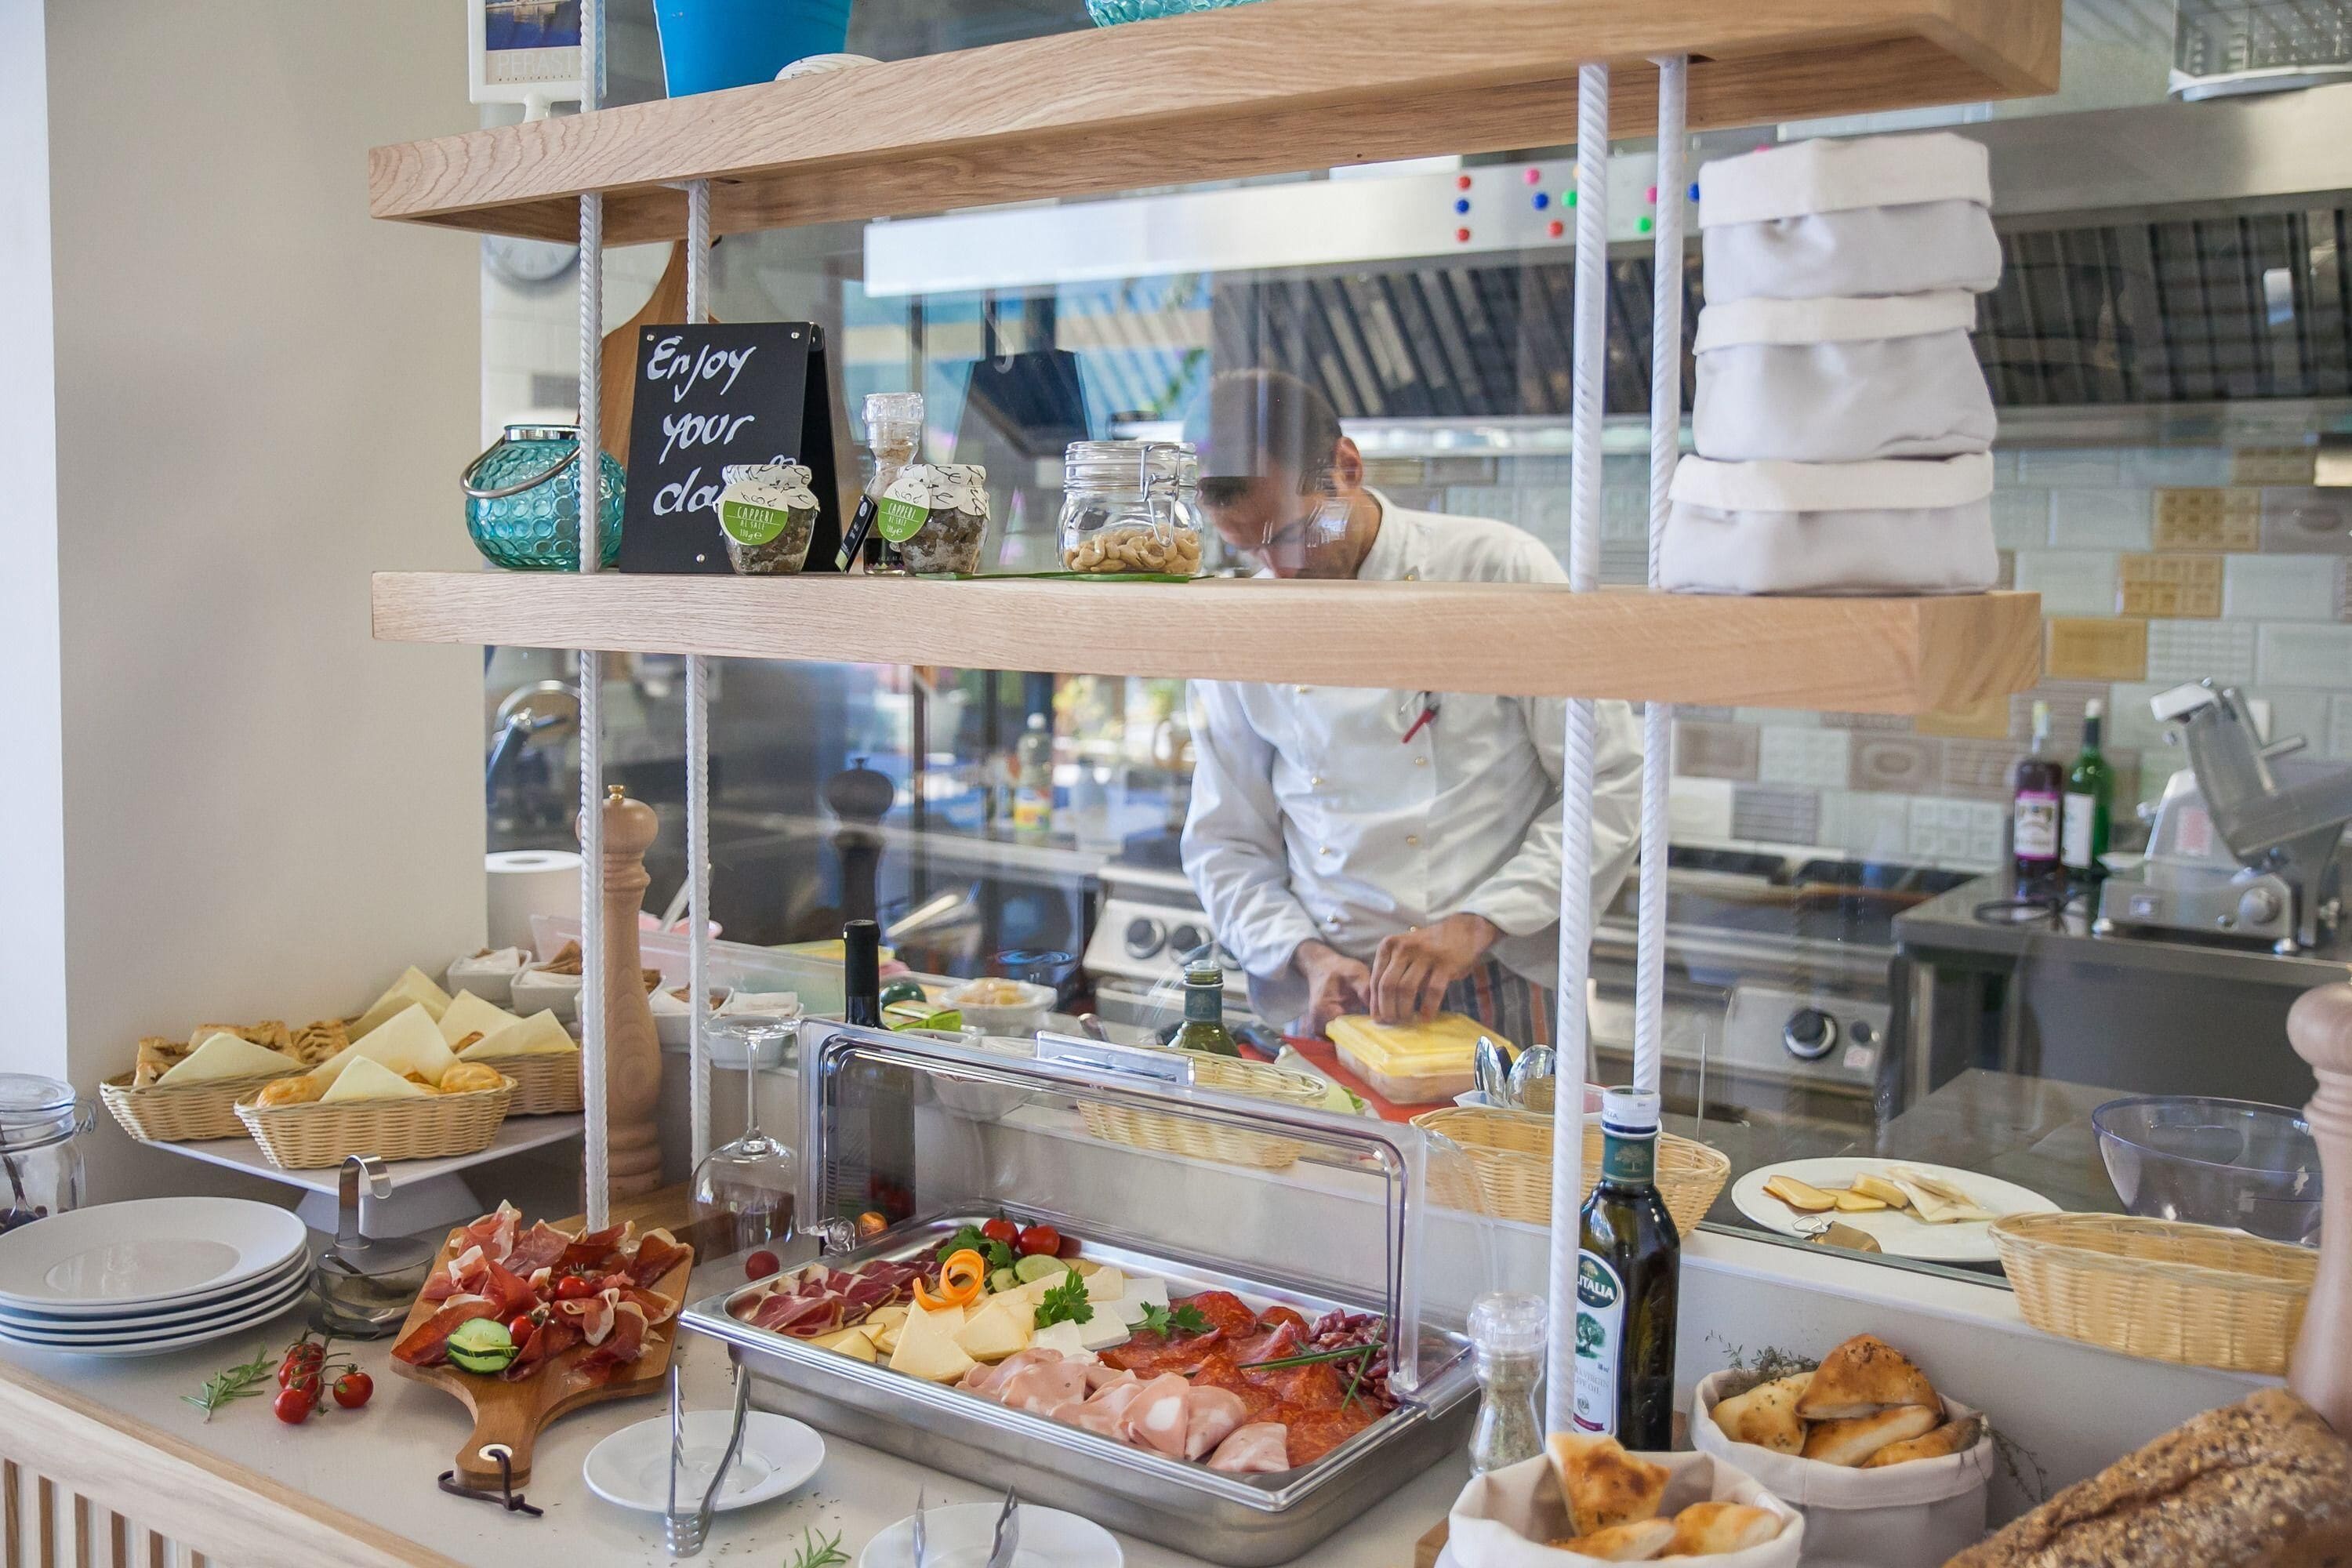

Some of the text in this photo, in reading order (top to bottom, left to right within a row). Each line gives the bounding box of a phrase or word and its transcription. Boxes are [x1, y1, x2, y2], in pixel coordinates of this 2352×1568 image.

[497, 50, 576, 76] PERAST
[647, 336, 757, 403] Enjoy
[659, 412, 755, 465] your
[653, 466, 722, 520] da
[737, 506, 774, 523] CAPPERI
[1577, 1274, 1614, 1301] ITALIA
